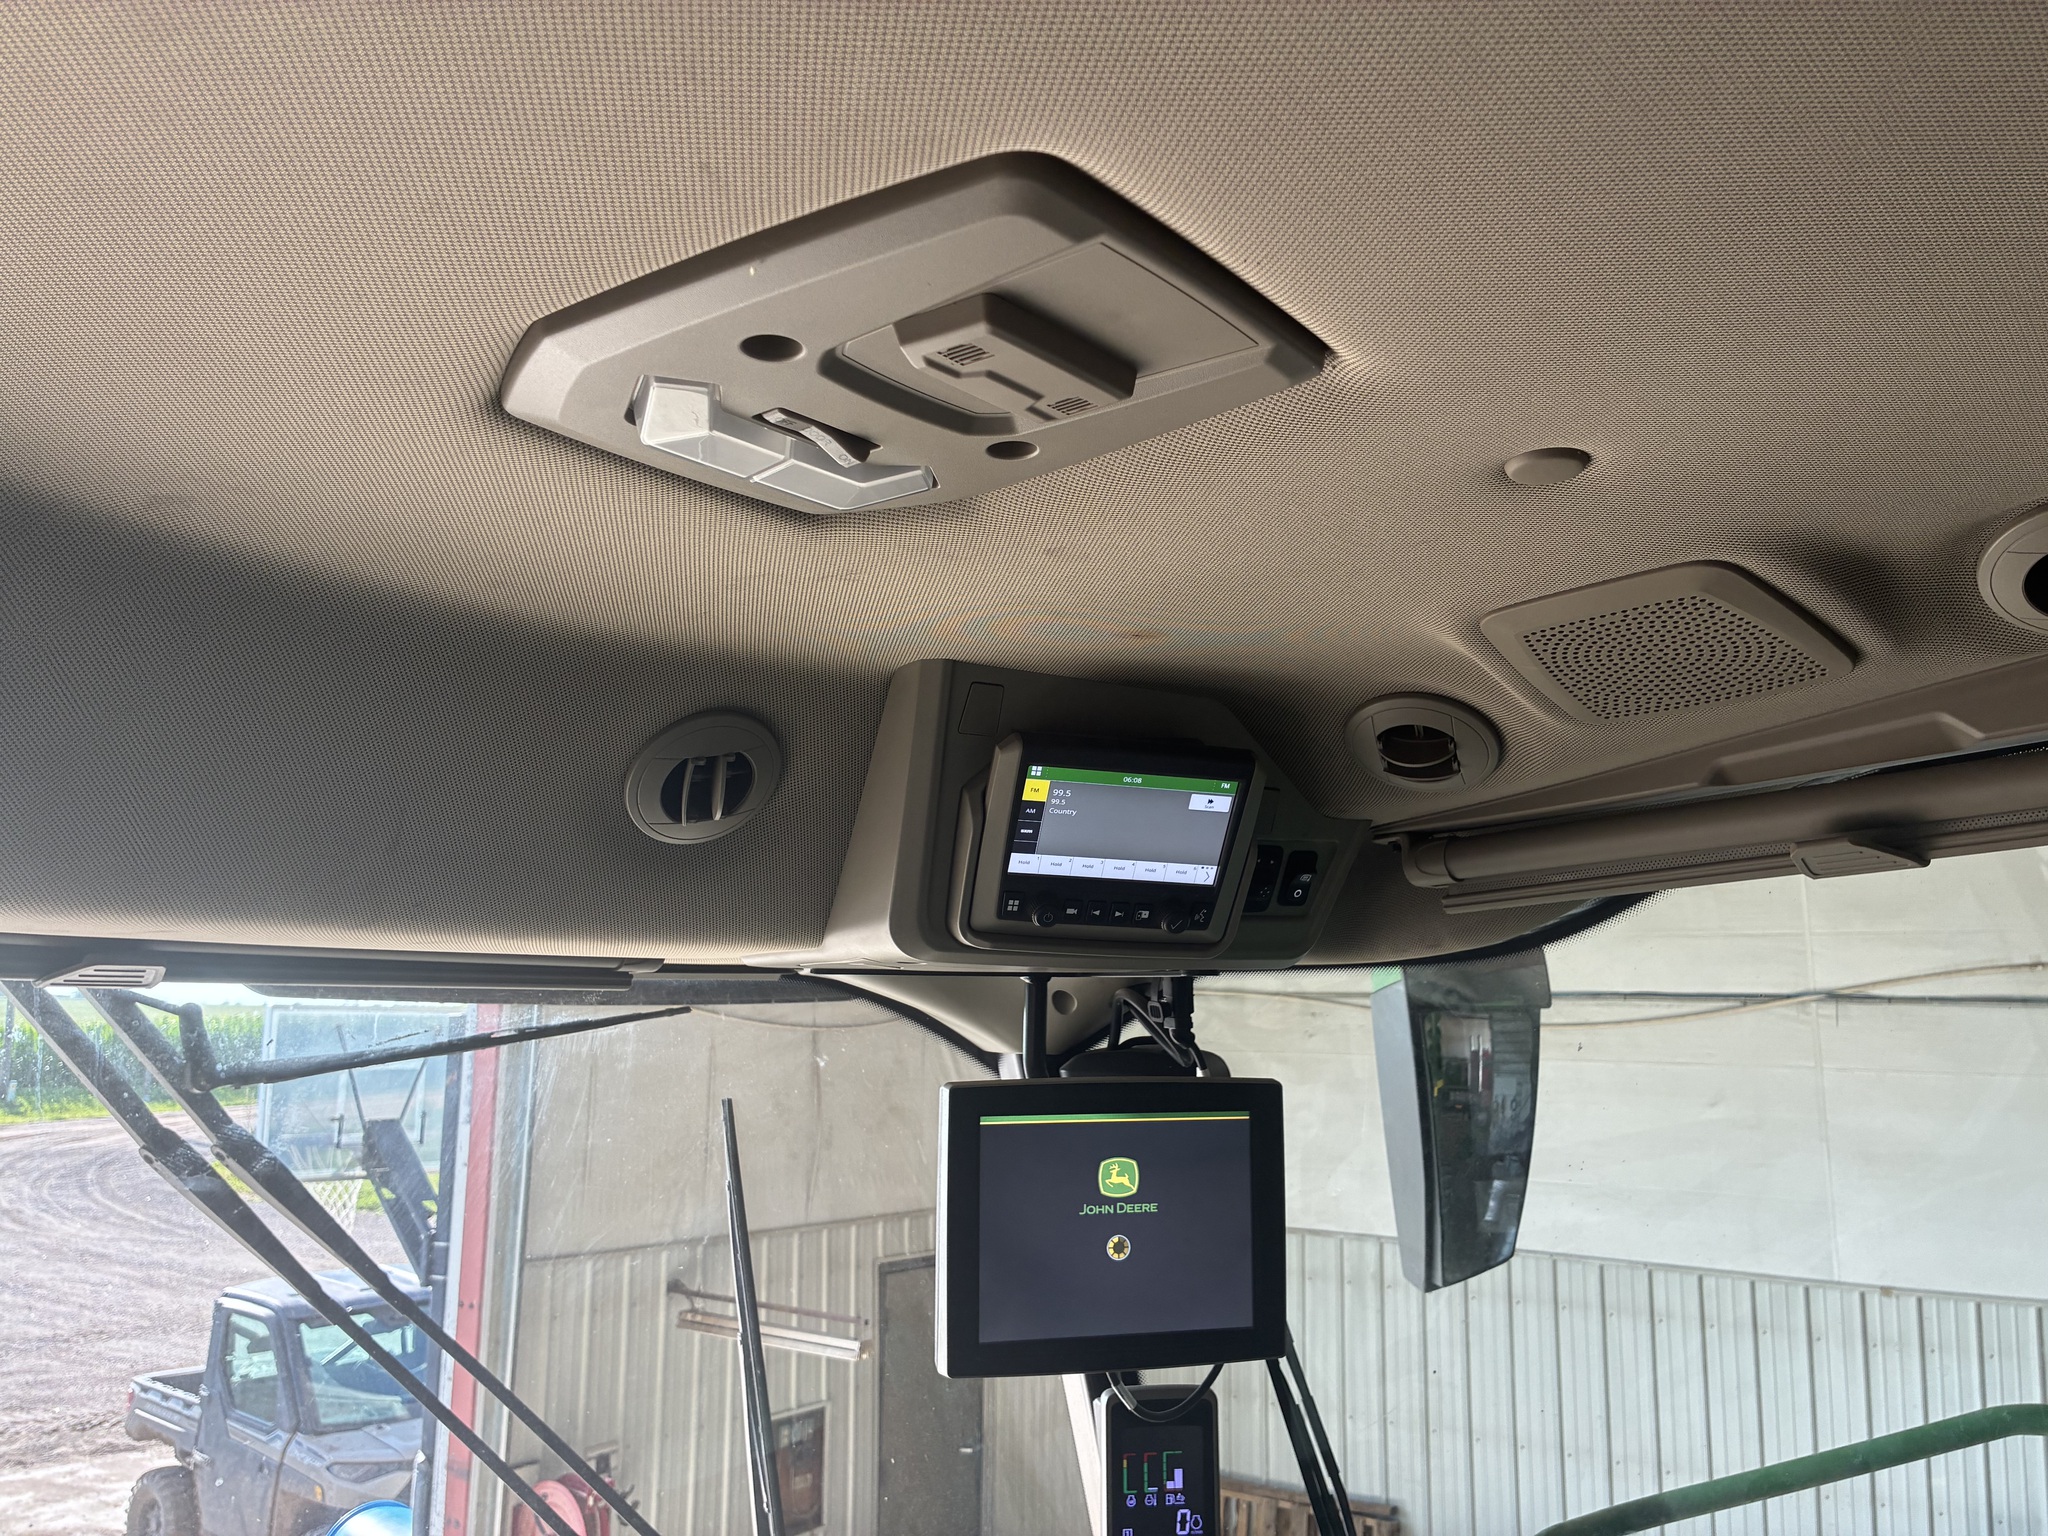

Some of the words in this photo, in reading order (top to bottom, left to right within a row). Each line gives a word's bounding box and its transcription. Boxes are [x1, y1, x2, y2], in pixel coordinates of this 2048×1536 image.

[1123, 776, 1142, 784] 06:08
[1052, 788, 1072, 797] 99.5
[1050, 798, 1066, 806] 99.5
[1048, 807, 1077, 817] Country
[1079, 1203, 1114, 1215] JOHN
[1116, 1202, 1159, 1214] DEERE
[1176, 1508, 1191, 1535] 0
